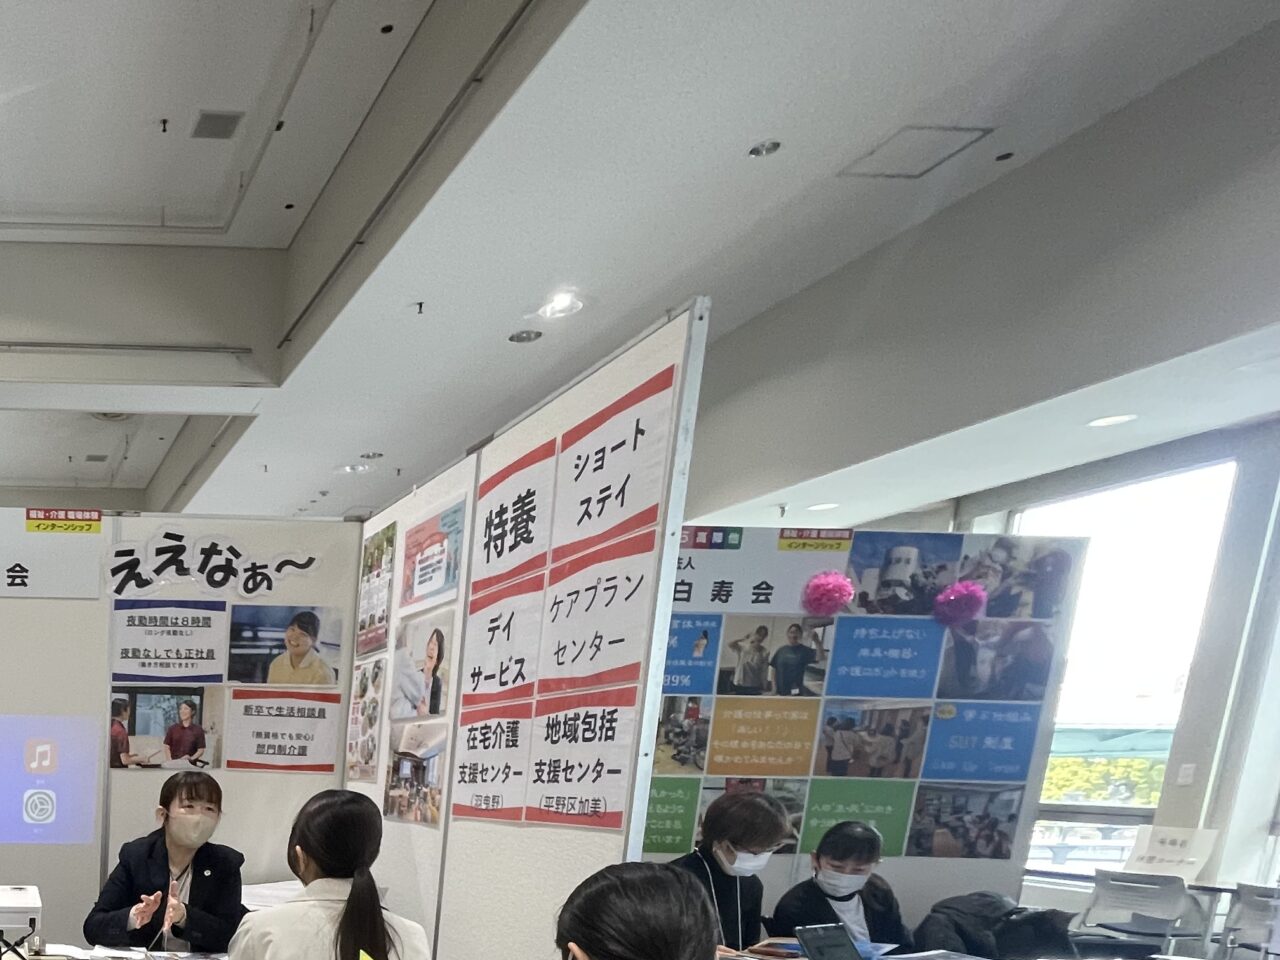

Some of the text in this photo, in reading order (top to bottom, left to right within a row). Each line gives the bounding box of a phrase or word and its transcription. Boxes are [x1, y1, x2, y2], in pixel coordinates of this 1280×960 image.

[573, 418, 646, 482] ショート
[576, 473, 631, 527] ステイ
[35, 523, 92, 531] インターンシップ
[483, 488, 537, 564] 特養
[549, 574, 645, 624] ケアプラン
[673, 580, 774, 604] 白寿会
[487, 611, 515, 647] デイ
[120, 648, 215, 660] 夜勤なしでも正社員
[553, 634, 626, 667] センター
[470, 656, 526, 693] サービス
[243, 705, 326, 719] 新卒で生活相談員
[544, 708, 618, 745] 地域包括
[467, 720, 520, 750] 在宅介護
[458, 762, 523, 784] 支援センター
[533, 758, 621, 784] 支援センター
